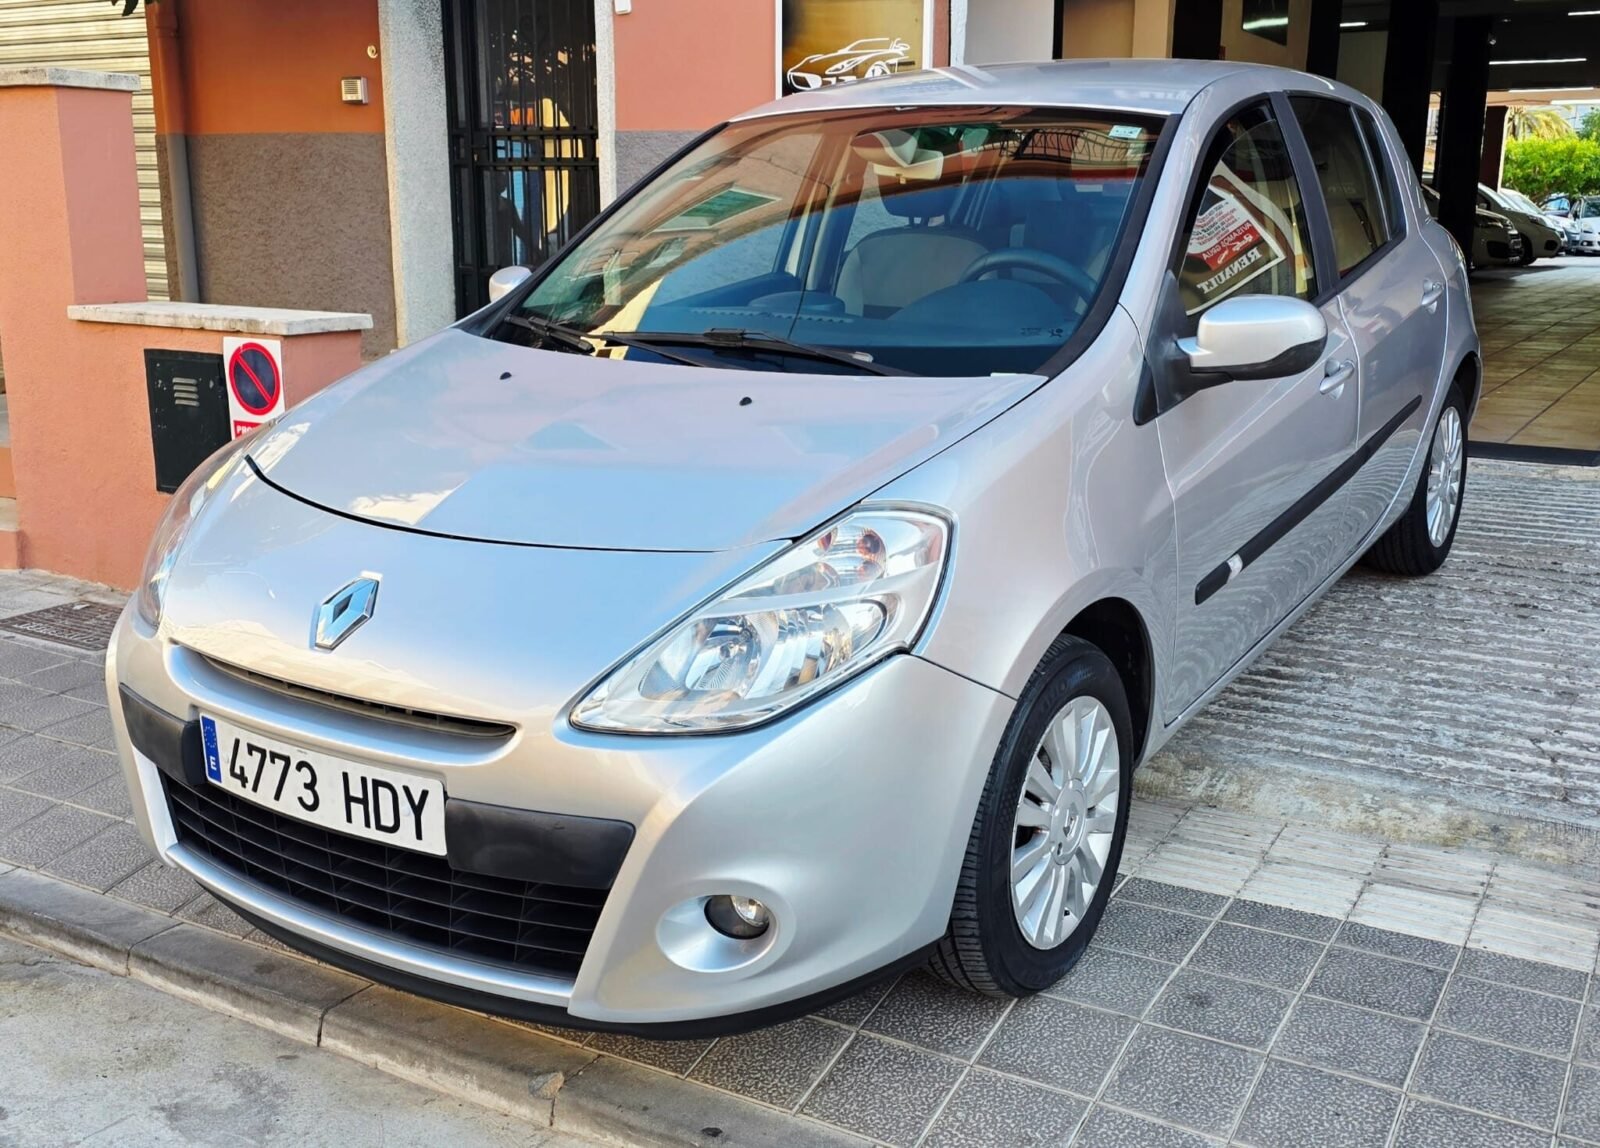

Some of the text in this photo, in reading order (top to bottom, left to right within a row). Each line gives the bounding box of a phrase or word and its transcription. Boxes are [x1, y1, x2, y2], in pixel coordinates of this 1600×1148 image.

[209, 755, 217, 771] E
[229, 738, 429, 840] 4773 HDY
